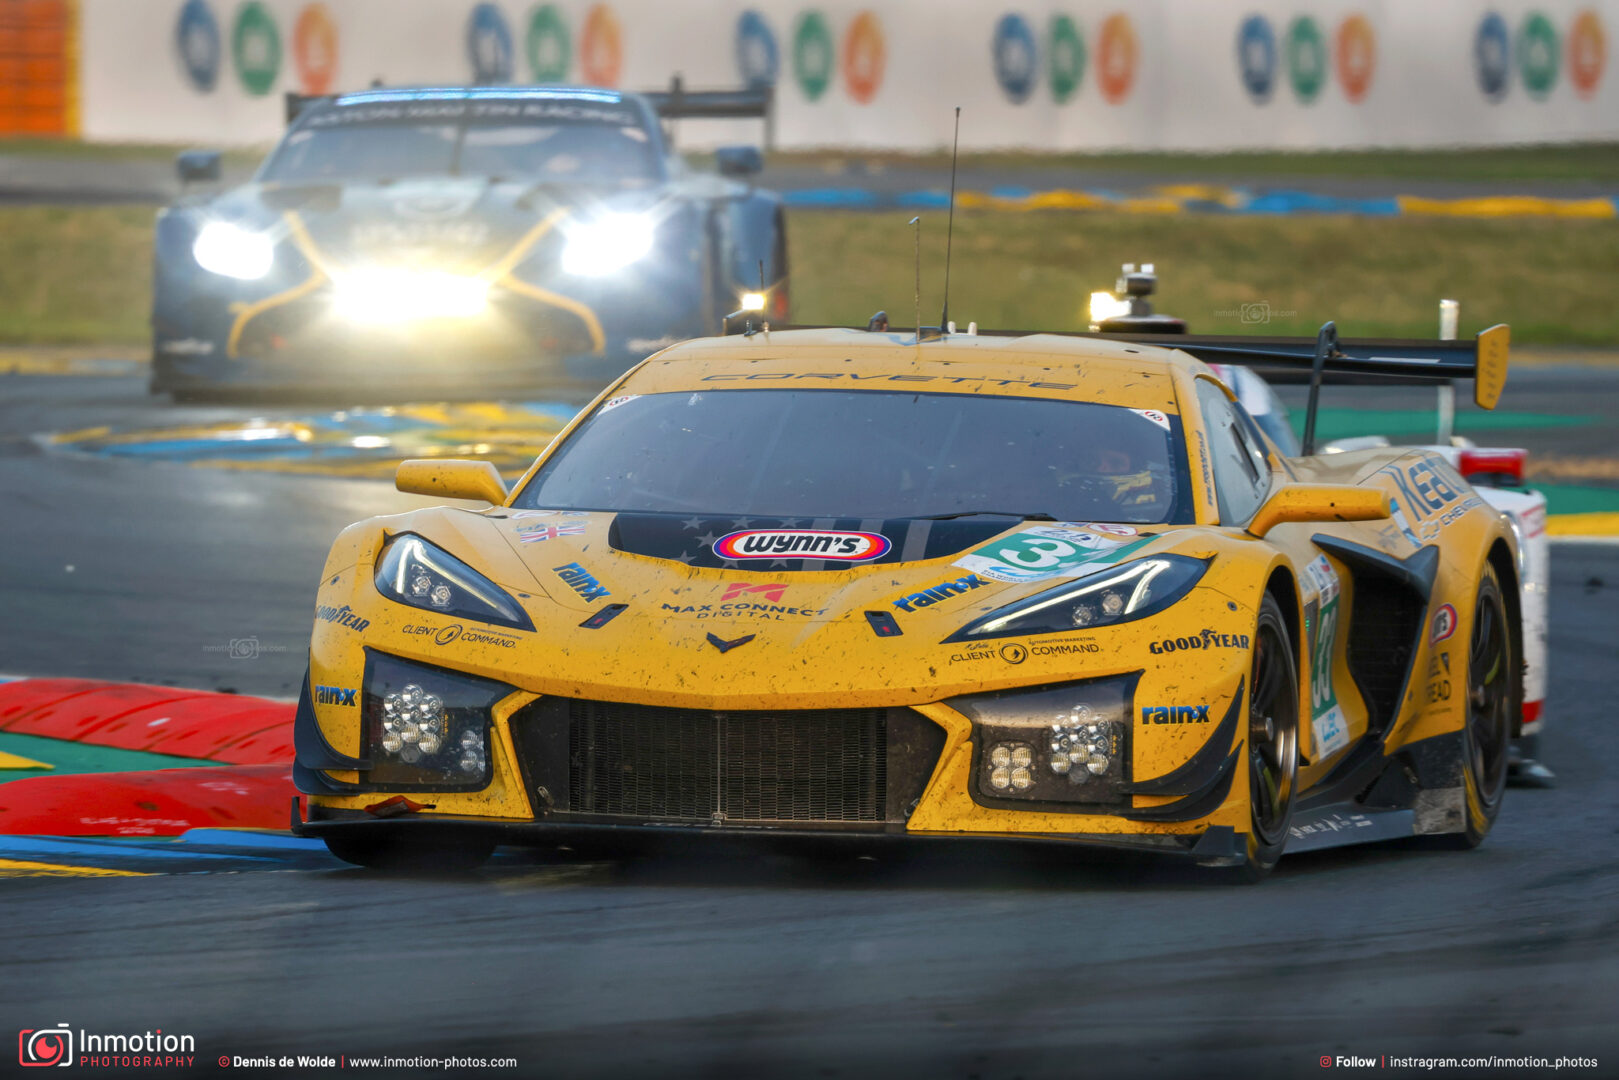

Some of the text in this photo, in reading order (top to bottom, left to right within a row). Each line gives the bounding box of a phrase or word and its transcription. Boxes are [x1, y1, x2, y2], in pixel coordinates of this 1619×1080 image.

[700, 373, 1078, 390] CORVETTE
[661, 603, 829, 617] MAX CONNECT
[696, 611, 785, 621] DIGITAL
[402, 624, 516, 648] CLIENT COMMAND
[1149, 631, 1250, 655] GOODYEAR
[951, 644, 1100, 662] CLIENT COMMAND
